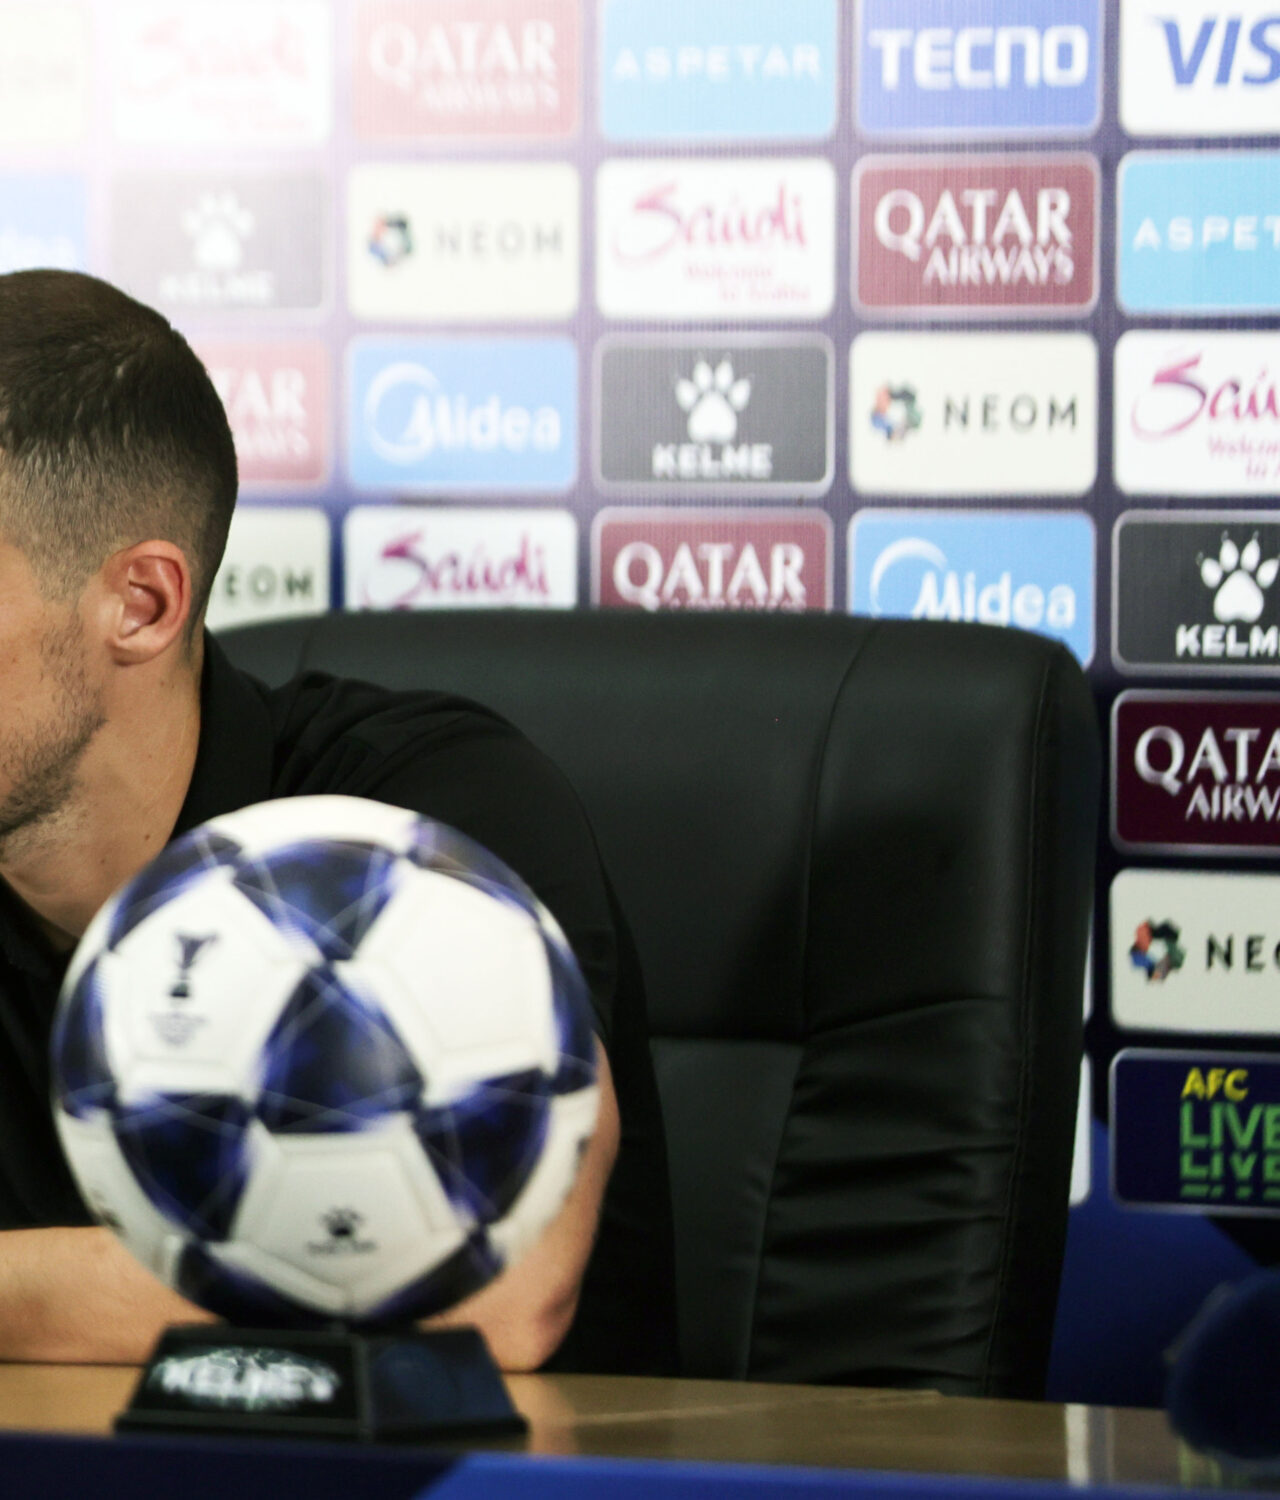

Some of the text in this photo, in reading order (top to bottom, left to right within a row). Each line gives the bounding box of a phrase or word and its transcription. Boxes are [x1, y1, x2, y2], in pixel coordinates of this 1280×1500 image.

[370, 20, 556, 90] QATAR
[613, 44, 820, 80] ASPETAR
[869, 25, 1089, 90] TECNO
[874, 187, 1072, 262] QATAR
[923, 245, 1075, 286] AIRWAYS
[402, 394, 562, 451] Midea
[943, 394, 1078, 430] NEOM
[651, 443, 773, 478] KELME
[224, 565, 315, 598] EOM
[613, 541, 808, 611] QATAR
[911, 571, 1077, 629] Midea
[1176, 623, 1280, 657] KELM
[1185, 783, 1280, 822] AIRW
[1206, 934, 1280, 972] NE
[1181, 1066, 1249, 1101] AFC
